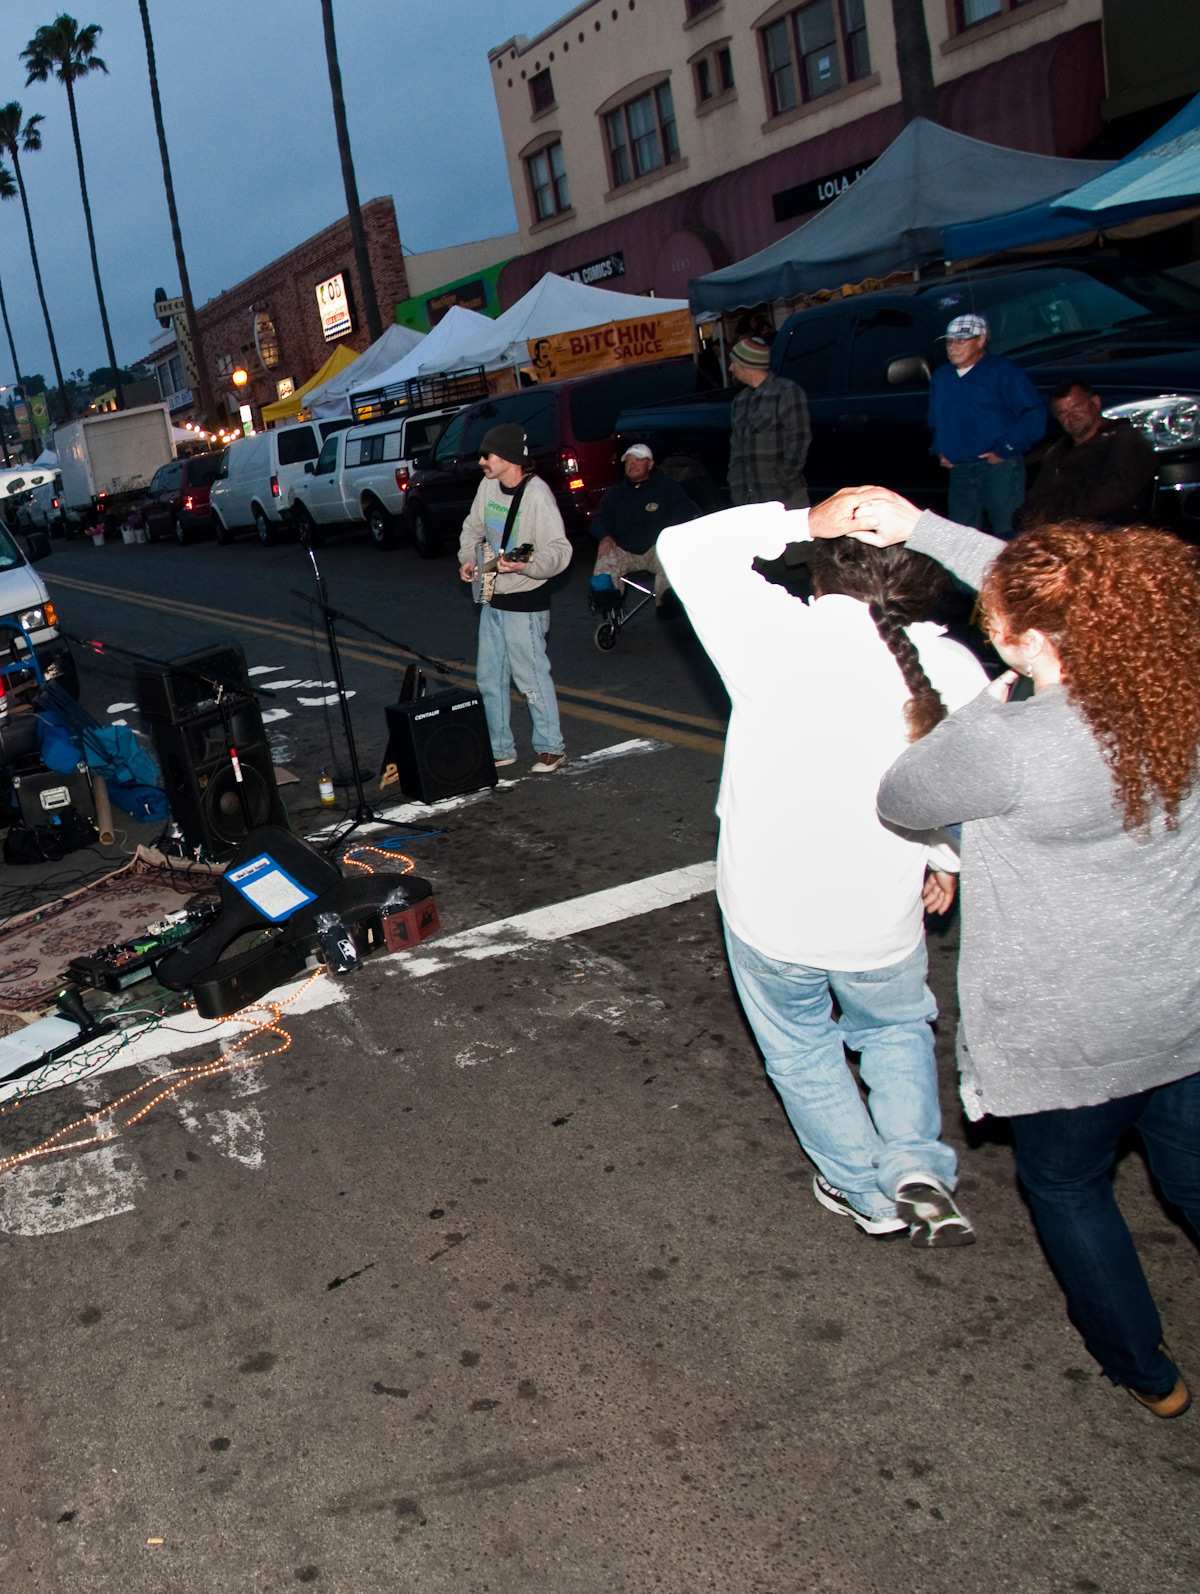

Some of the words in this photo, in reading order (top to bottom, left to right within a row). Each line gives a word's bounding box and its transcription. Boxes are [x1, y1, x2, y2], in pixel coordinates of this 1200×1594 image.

[818, 176, 849, 200] LOLA
[582, 260, 612, 284] COMICS
[569, 320, 661, 356] BITCHIN'
[613, 339, 664, 360] SAUCE
